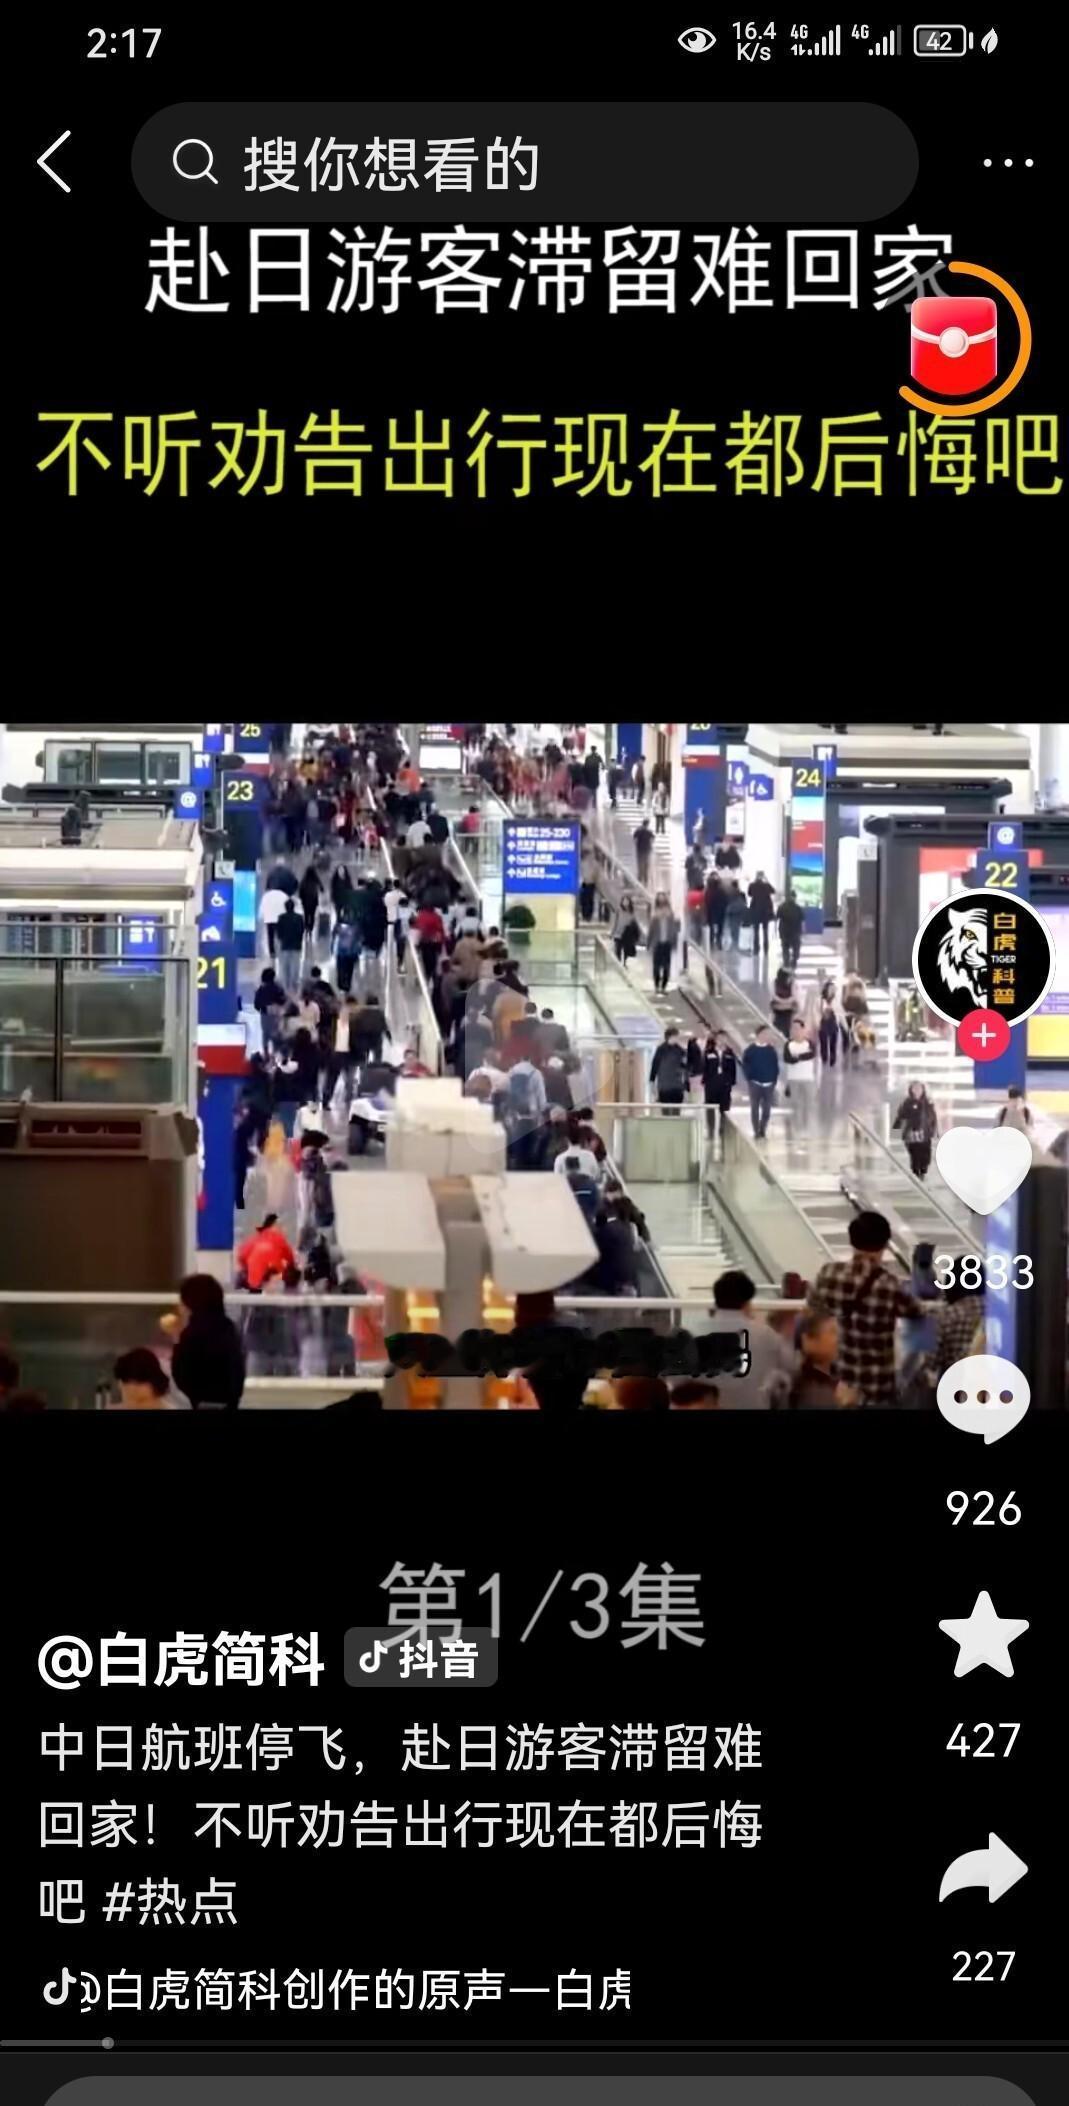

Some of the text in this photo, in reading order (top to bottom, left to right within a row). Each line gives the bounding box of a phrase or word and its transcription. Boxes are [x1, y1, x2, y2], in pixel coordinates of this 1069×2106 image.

[795, 769, 821, 787] 24
[227, 781, 253, 801] 23
[984, 862, 1018, 888] 22
[197, 957, 225, 989] 21
